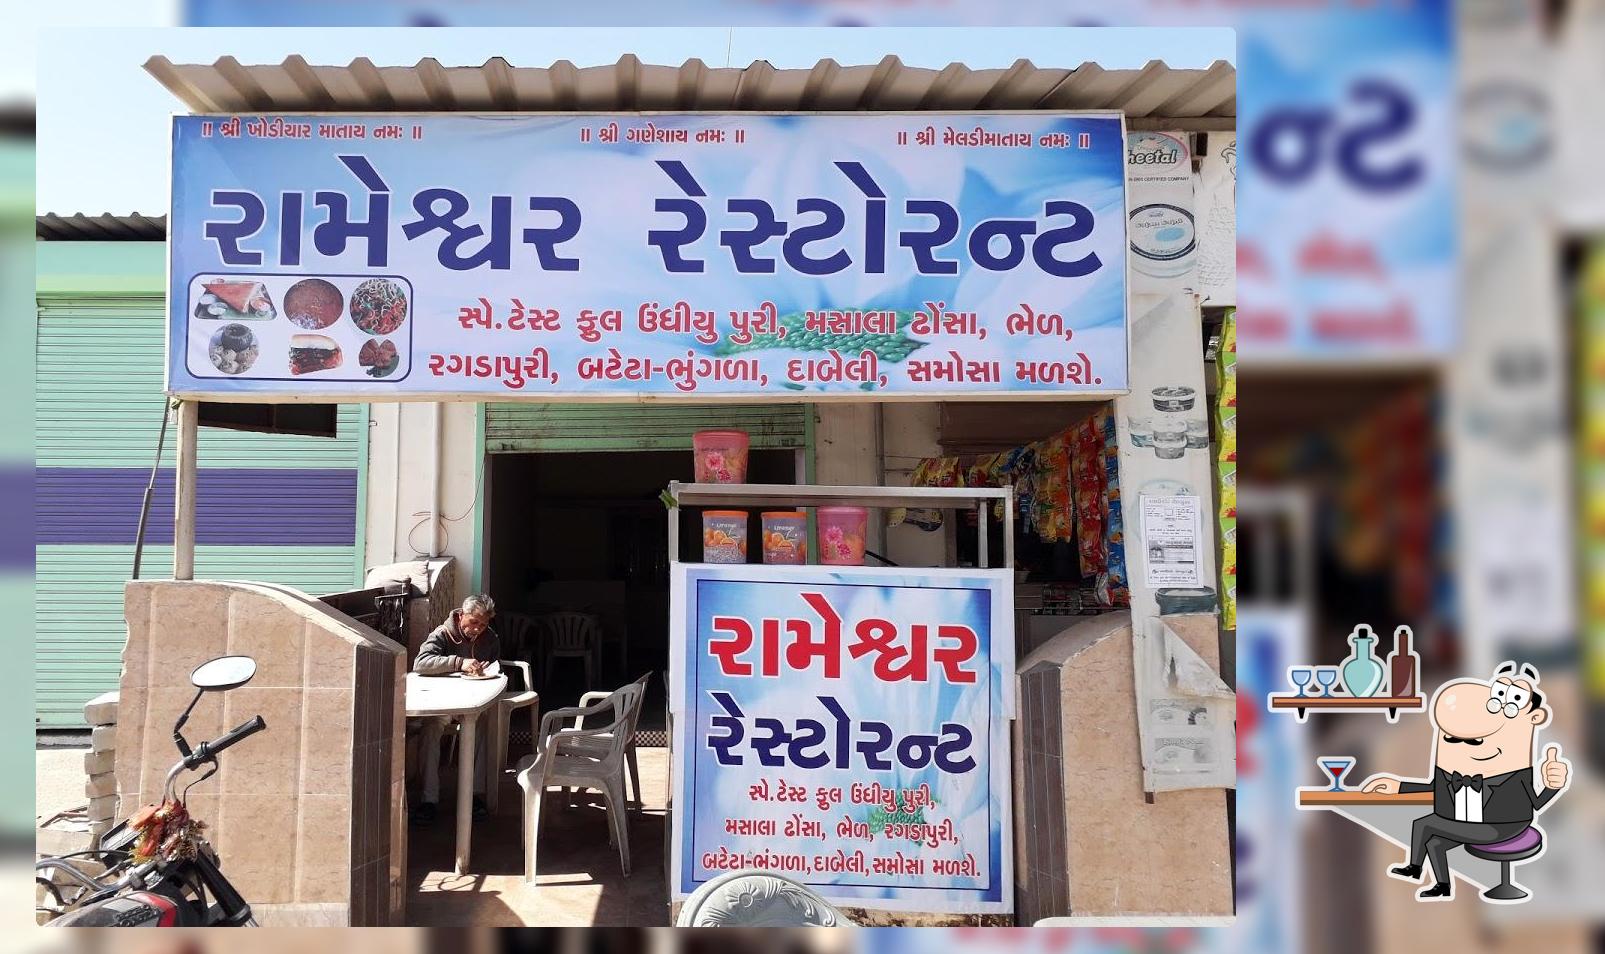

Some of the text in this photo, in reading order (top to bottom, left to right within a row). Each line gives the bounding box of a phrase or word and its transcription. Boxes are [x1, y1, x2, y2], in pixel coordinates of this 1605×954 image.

[220, 118, 240, 137] શ્રી
[248, 118, 311, 138] ખોડીયાર
[319, 124, 366, 139] માતાય
[599, 122, 618, 142] શ્રી
[626, 123, 688, 143] ગણેશાય
[916, 126, 935, 146] શ્રી
[943, 126, 1032, 147] મેલડીમાતાય
[204, 154, 583, 272] રામેશ્વર
[648, 160, 1104, 278] રેસ્ટોરન્ટ
[730, 301, 788, 344] પુરી,
[805, 310, 896, 335] મસાલા
[911, 301, 987, 341] ઢોંસા,
[1006, 303, 1073, 342] ભેળ,
[428, 347, 559, 390] રગડાપુરી,
[787, 350, 888, 388] દાબેલી,
[907, 351, 1000, 383] સમોસા
[1015, 352, 1103, 385] મળશે.
[709, 593, 978, 684] રામેશ્વર
[708, 692, 977, 774] રેસ્ટોરન્ટ
[903, 783, 936, 814] પુરી,
[725, 813, 960, 849] મસાલા ઢોંસા, ભેળ, રગડાપુરી,
[932, 853, 981, 877] મળશે.
